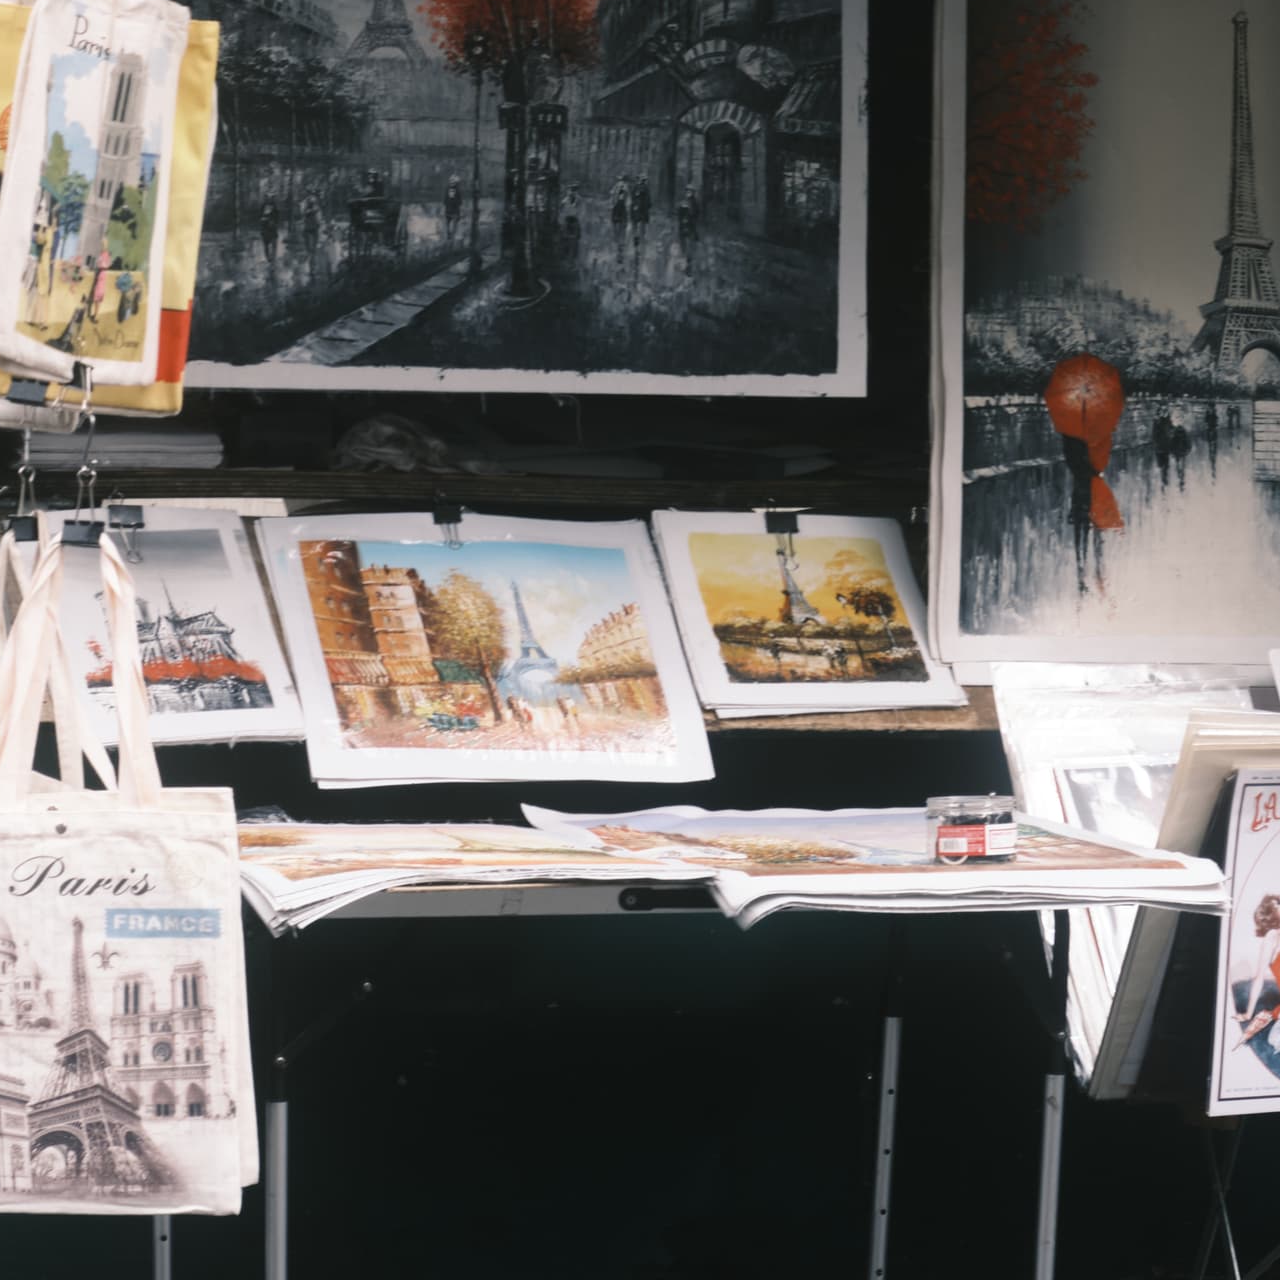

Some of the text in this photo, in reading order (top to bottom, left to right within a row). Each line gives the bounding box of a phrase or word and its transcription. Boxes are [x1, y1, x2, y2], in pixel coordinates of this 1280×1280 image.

[67, 13, 112, 61] Paris
[8, 855, 157, 898] Paris
[112, 913, 214, 933] FRANCE
